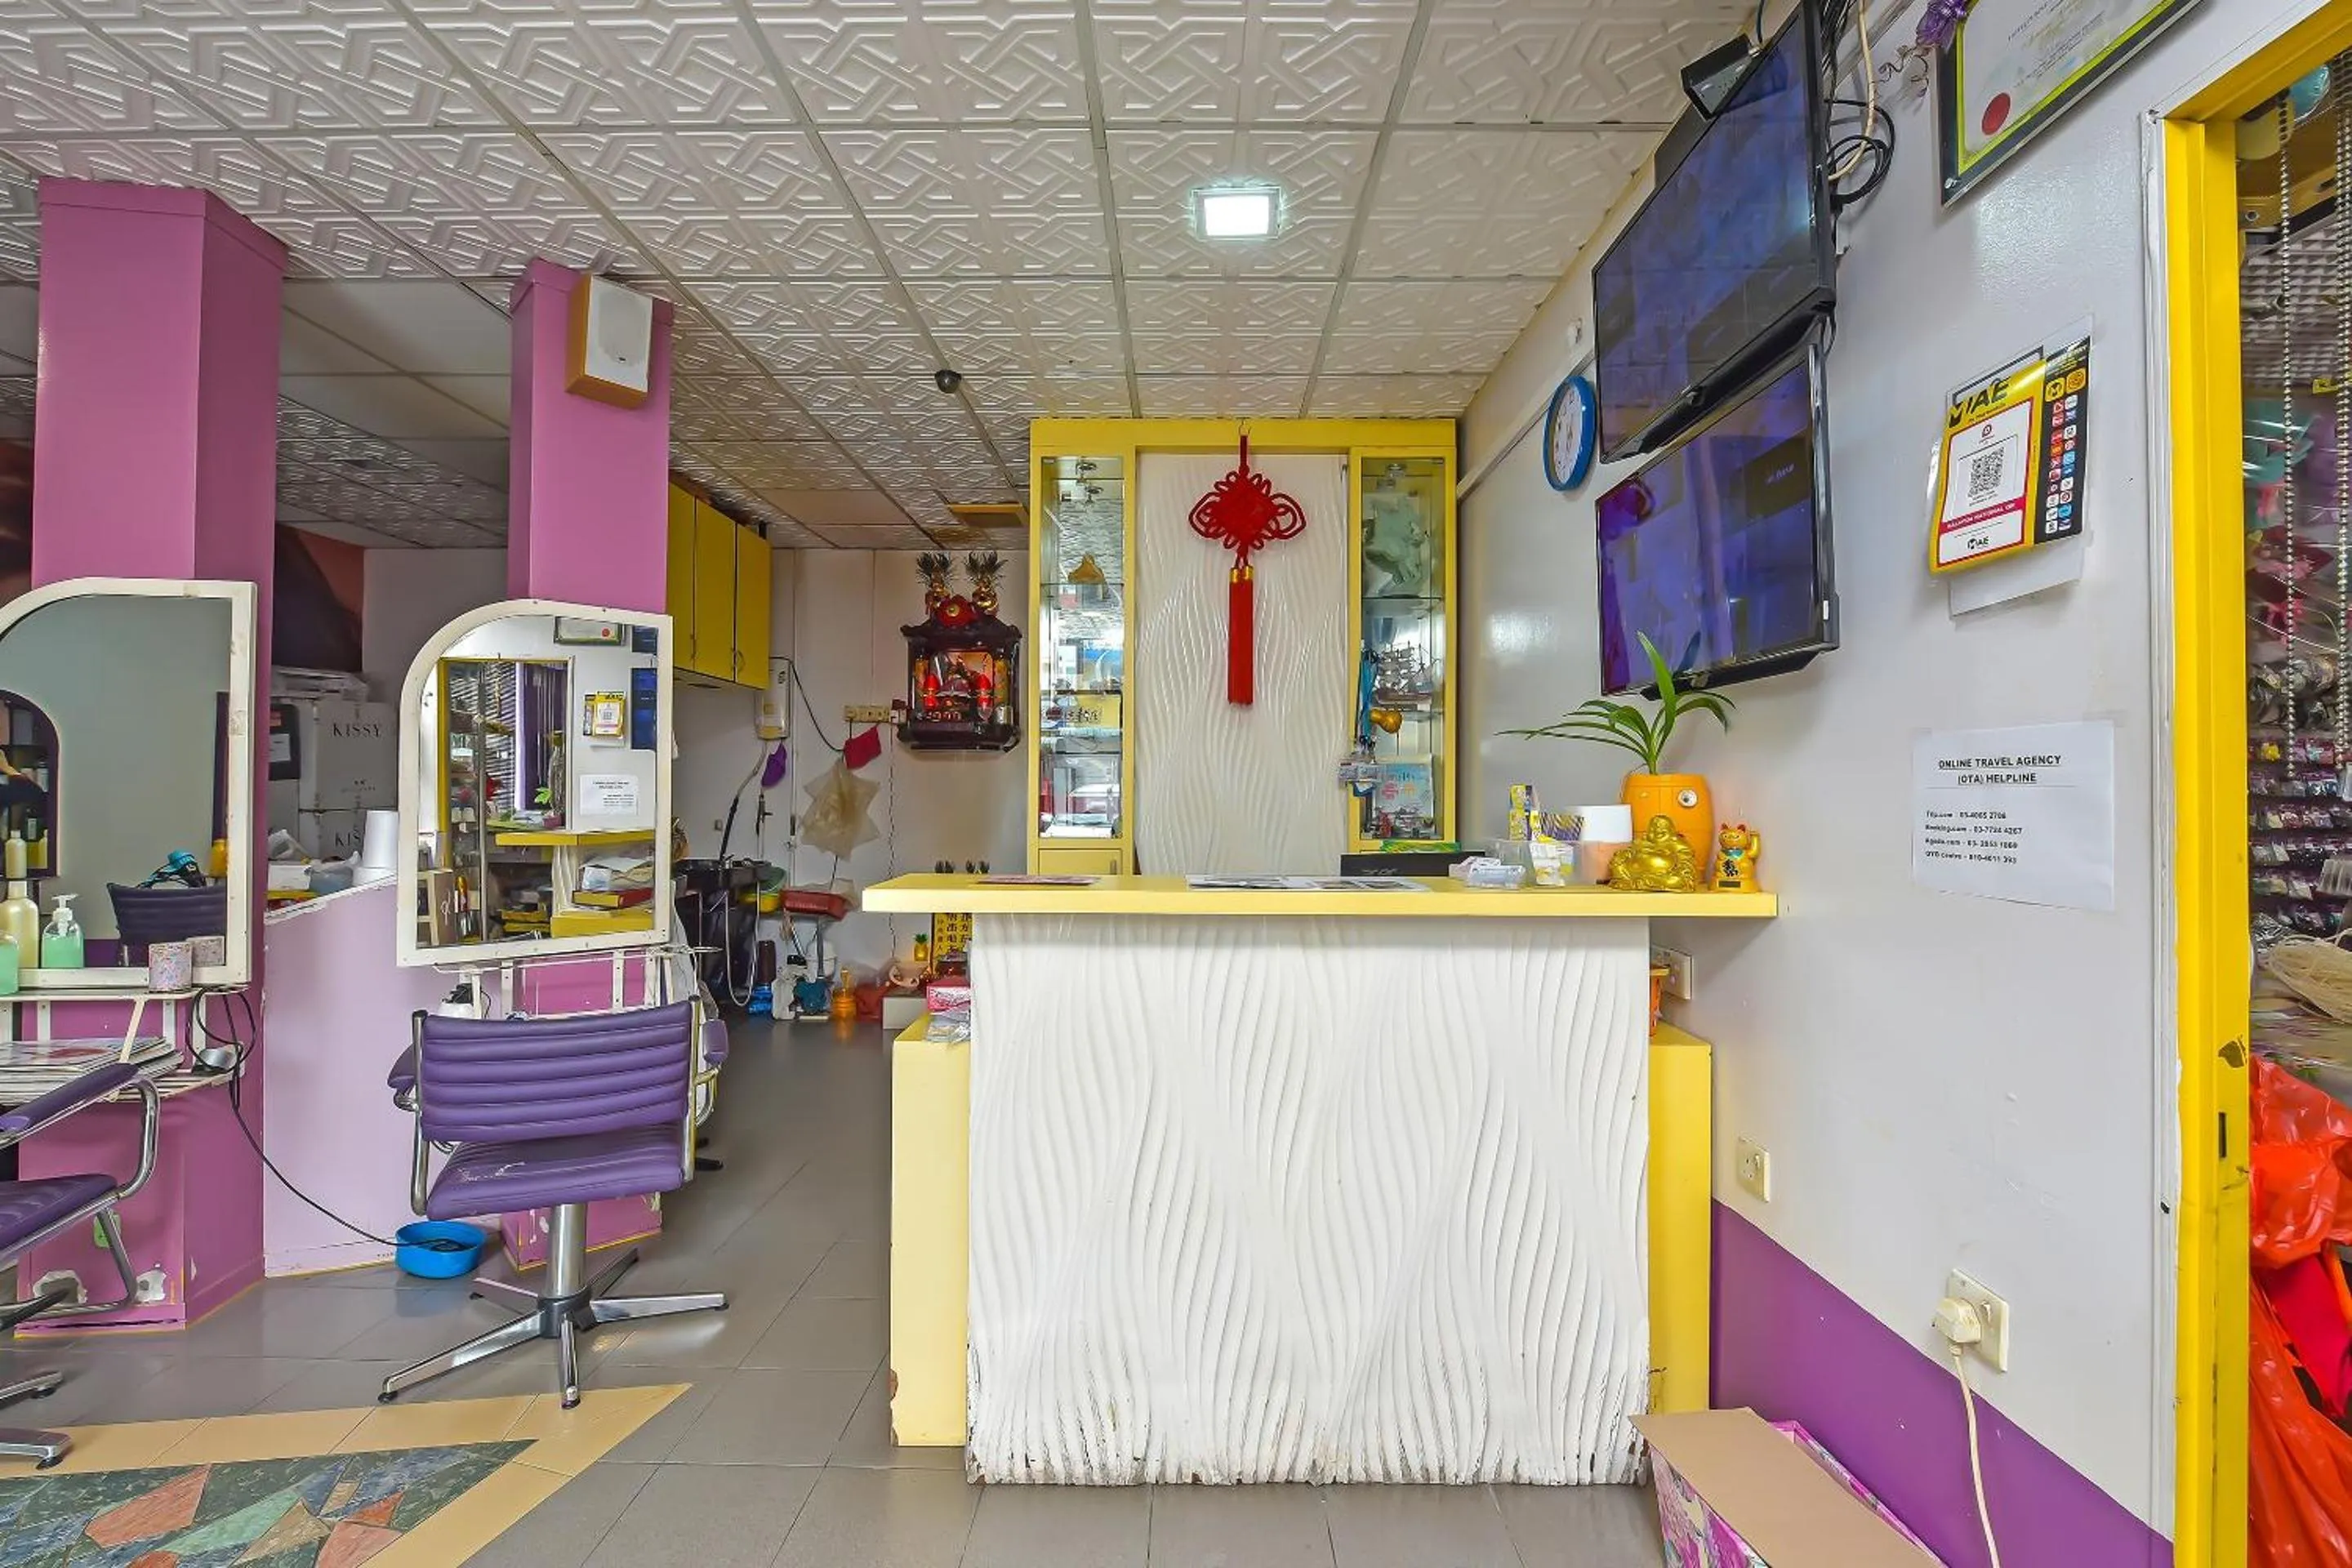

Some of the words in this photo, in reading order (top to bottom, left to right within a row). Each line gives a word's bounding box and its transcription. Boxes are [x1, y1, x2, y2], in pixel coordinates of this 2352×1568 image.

[333, 724, 381, 737] KISSY
[1939, 758, 1972, 769] ONLINE
[1976, 757, 2013, 768] TRAVEL
[2016, 755, 2062, 766] AGENCY
[1958, 774, 1984, 785] (OTA)
[1987, 773, 2037, 784] HELPLINE
[335, 831, 363, 848] KIS
